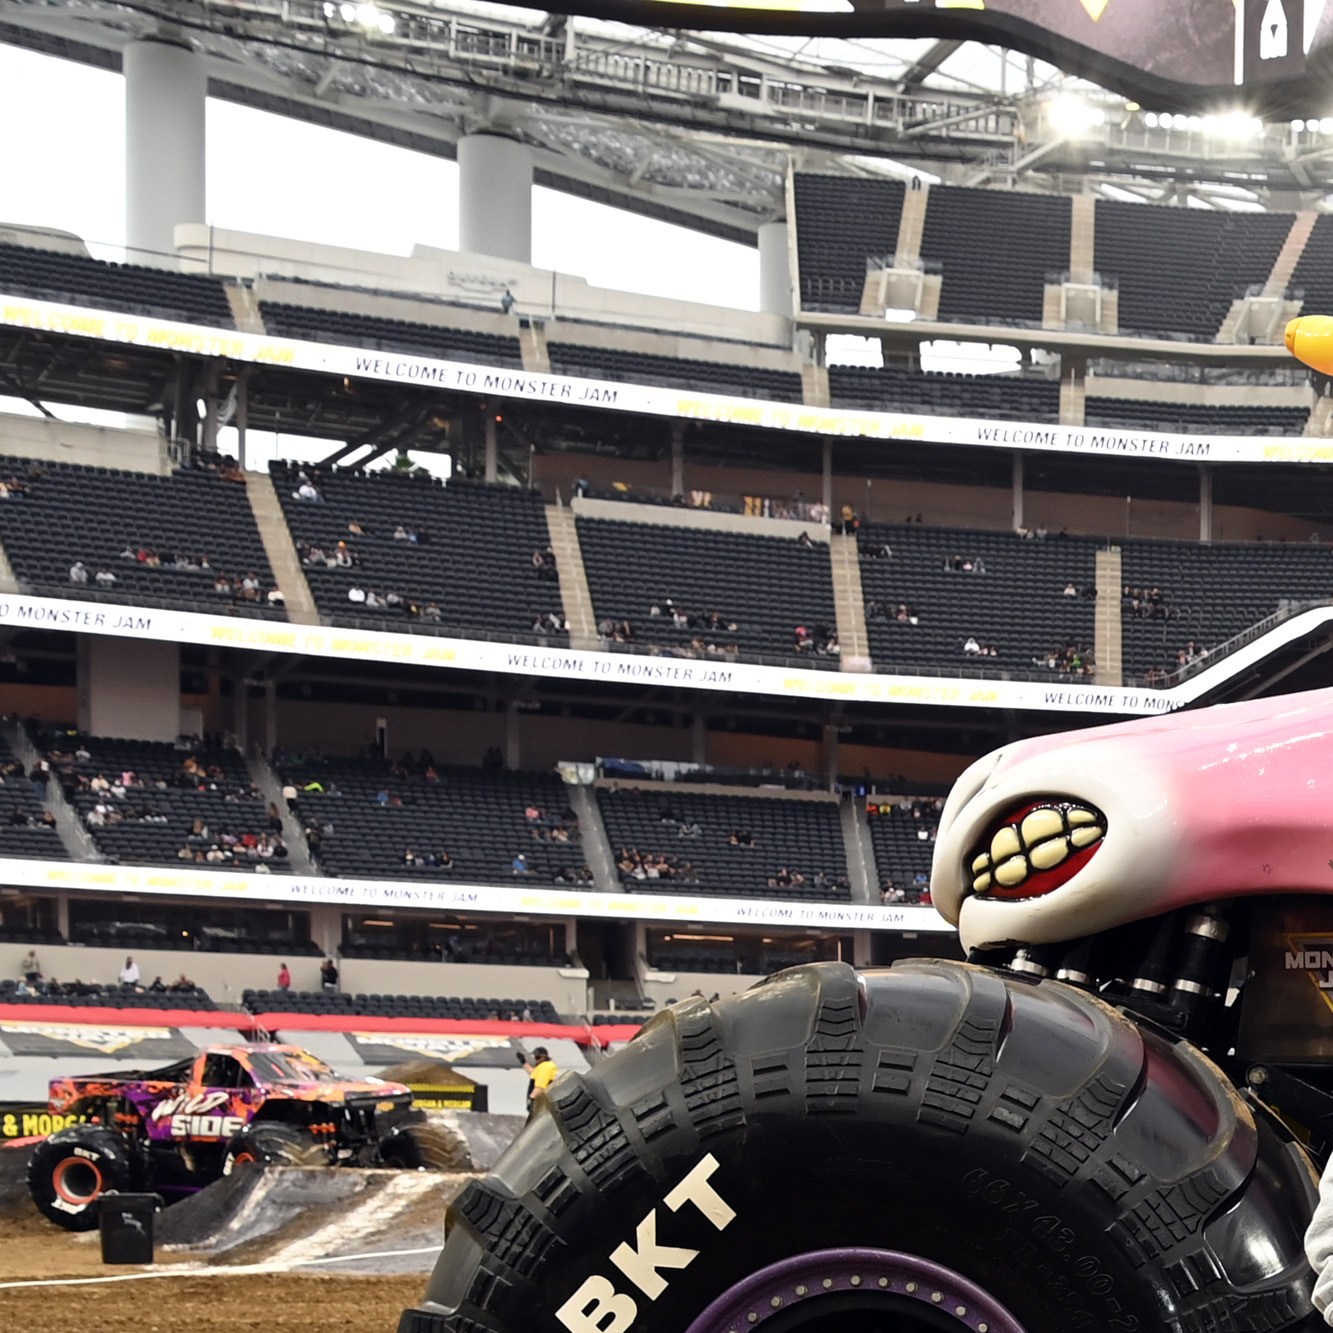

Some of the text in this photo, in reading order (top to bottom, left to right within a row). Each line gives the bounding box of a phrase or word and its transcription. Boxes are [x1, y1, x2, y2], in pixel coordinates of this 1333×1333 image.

[356, 357, 618, 403] WELCOME TO MONSTER JAM
[978, 427, 1211, 456] WELCOME TO MONSTER JAM
[0, 604, 151, 630] O MONSTER JAM
[508, 653, 732, 683] WELCOME TO MONSTER JAM
[1044, 692, 1117, 707] WELCOME
[1122, 694, 1138, 708] TO
[152, 1091, 229, 1122] WILD
[3, 1114, 87, 1137] & MORG
[171, 1115, 244, 1137] SIDE
